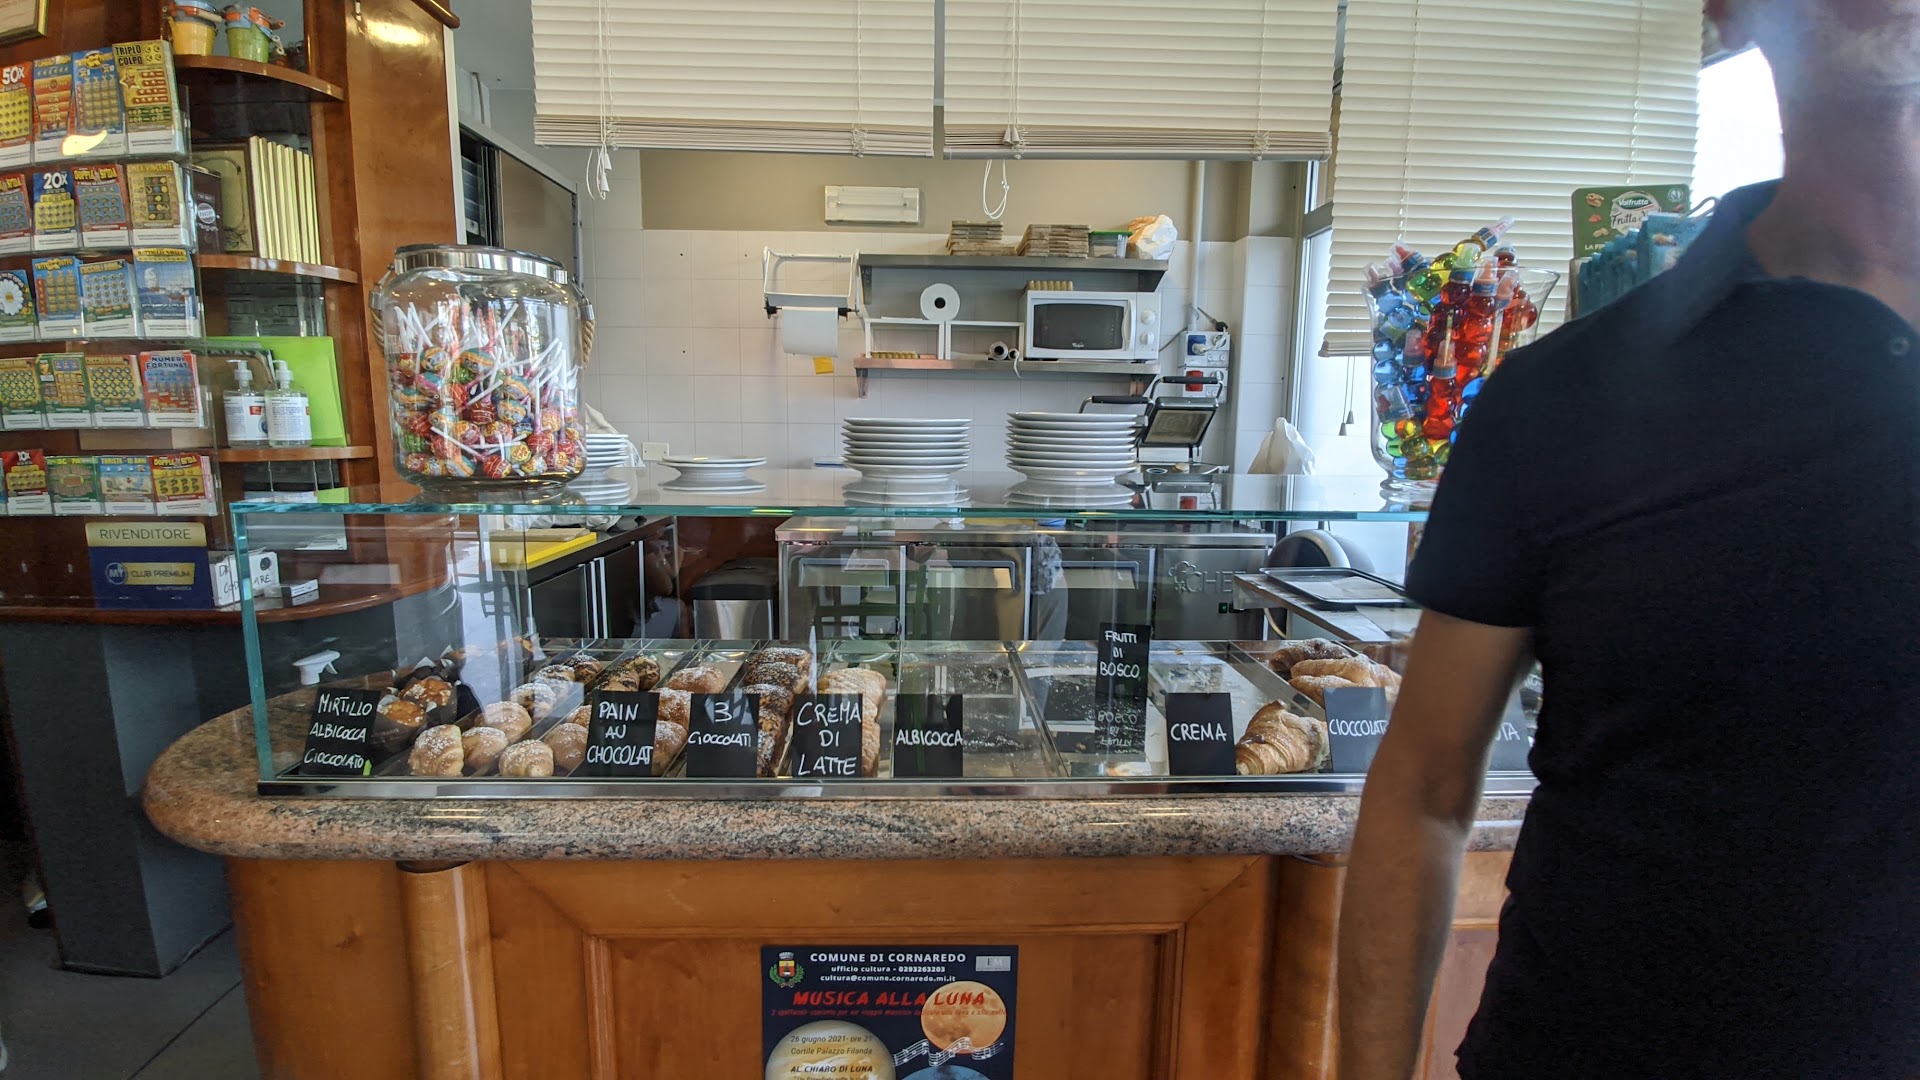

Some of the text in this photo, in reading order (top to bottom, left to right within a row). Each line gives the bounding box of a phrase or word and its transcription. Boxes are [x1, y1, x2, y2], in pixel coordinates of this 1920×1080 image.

[114, 45, 142, 56] TRIPLO
[118, 55, 143, 66] COLPO
[2, 66, 26, 85] 50X
[43, 172, 67, 190] 20X
[1618, 198, 1649, 206] Valfrutta
[1611, 214, 1637, 226] Frutta
[146, 362, 189, 370] FORTUNATI
[100, 528, 192, 540] RIVENDITORE
[130, 570, 152, 578] CLUB
[154, 570, 190, 578] PREMIUM
[1104, 630, 1138, 644] FRUTTI
[1112, 649, 1123, 659] DI
[1100, 662, 1140, 679] BOSCO
[317, 693, 373, 717] MIRTILLO
[599, 702, 639, 721] PAIN
[714, 702, 733, 722] 3
[797, 701, 863, 725] CREMA
[309, 721, 367, 743] ALBICOCCA
[604, 724, 626, 739] AU
[818, 731, 840, 747] DI
[895, 729, 964, 747] ALBICOCCA
[1170, 723, 1228, 742] CREMA
[303, 748, 365, 769] CIOCCOLATO
[586, 745, 654, 766] CHOCOLAT
[797, 756, 857, 776] LATTE
[810, 953, 966, 963] COMUNE DI CORNAREDO
[831, 965, 859, 973] ufficio
[898, 965, 946, 973] 0293263203
[820, 974, 956, 983] cultura@comune.cornaredo.mi.it
[793, 991, 985, 1006] MUSICA ALLA LUNA
[790, 1035, 800, 1043] 26
[801, 1036, 826, 1044] giugno
[791, 1047, 873, 1055] Cortile Palazzo Filanda
[790, 1065, 873, 1073] AL CHIARO DI LUNA
